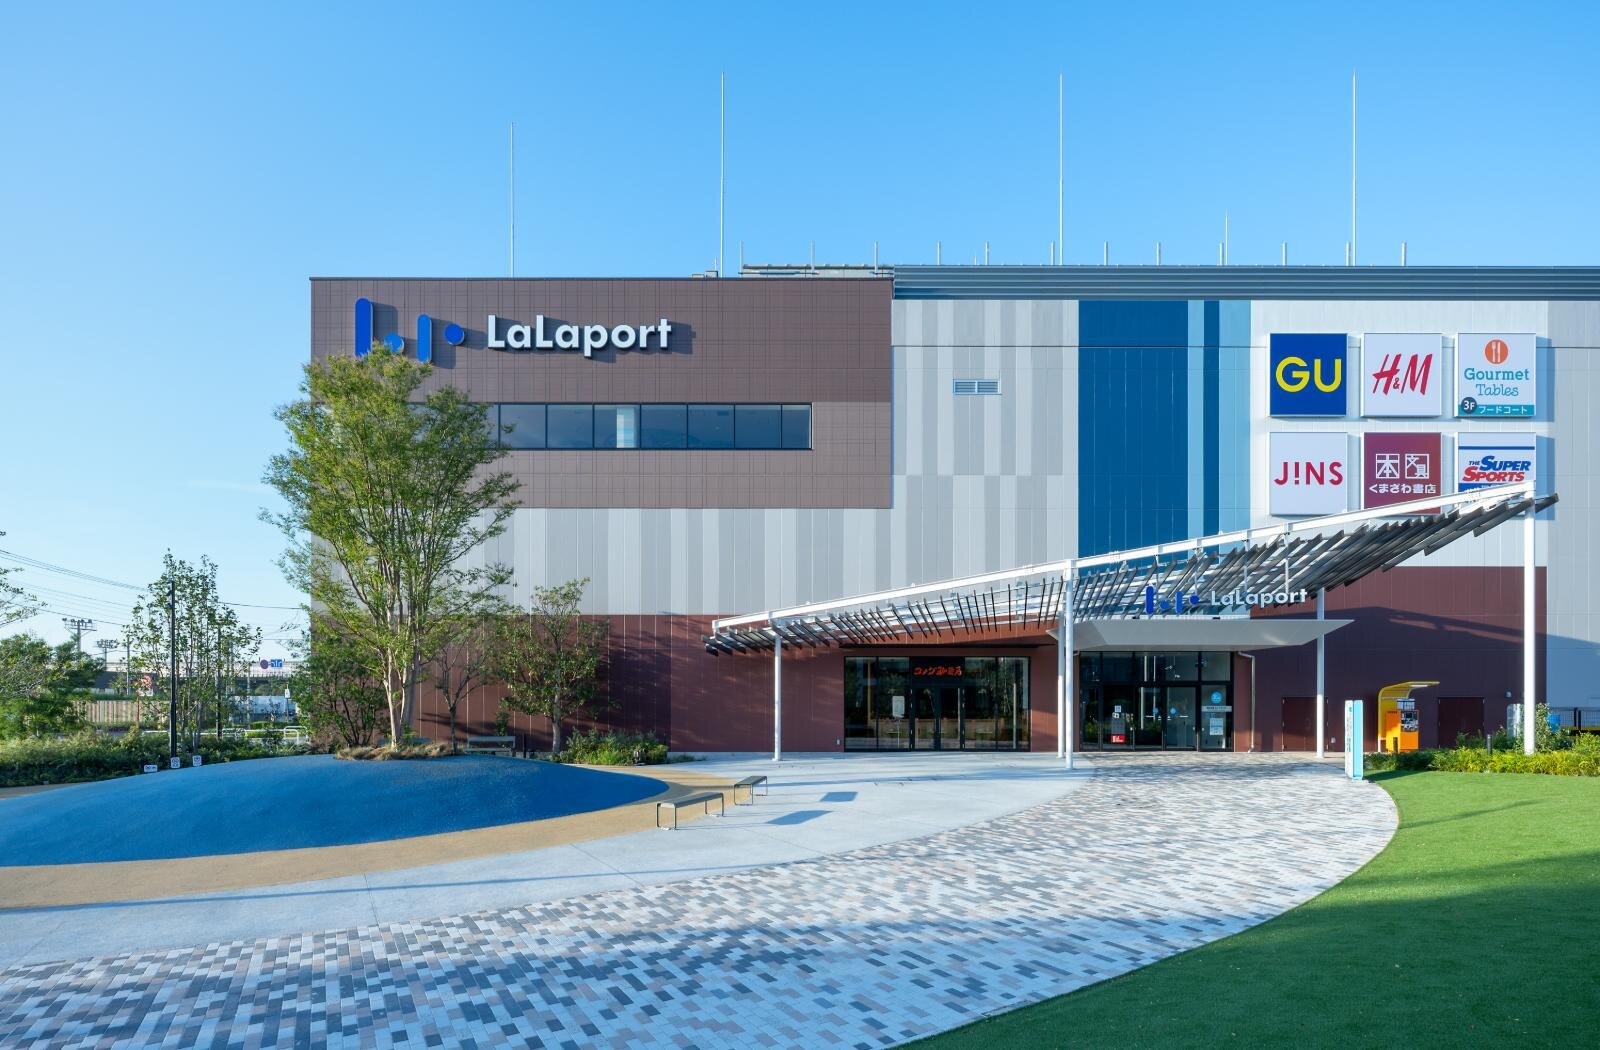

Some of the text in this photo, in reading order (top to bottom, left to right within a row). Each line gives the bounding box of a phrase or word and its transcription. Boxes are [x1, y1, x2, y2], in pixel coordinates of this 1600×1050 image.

[488, 315, 671, 357] LaLaport
[1276, 357, 1342, 393] GU
[1373, 353, 1433, 395] H&M
[1464, 368, 1529, 381] Gourmet
[1475, 384, 1519, 397] Tables
[1463, 400, 1475, 410] 3F
[1478, 405, 1528, 414] フードコート
[1479, 455, 1531, 471] SUPER
[1462, 466, 1525, 482] SPORTS
[1211, 589, 1308, 608] LaLaport
